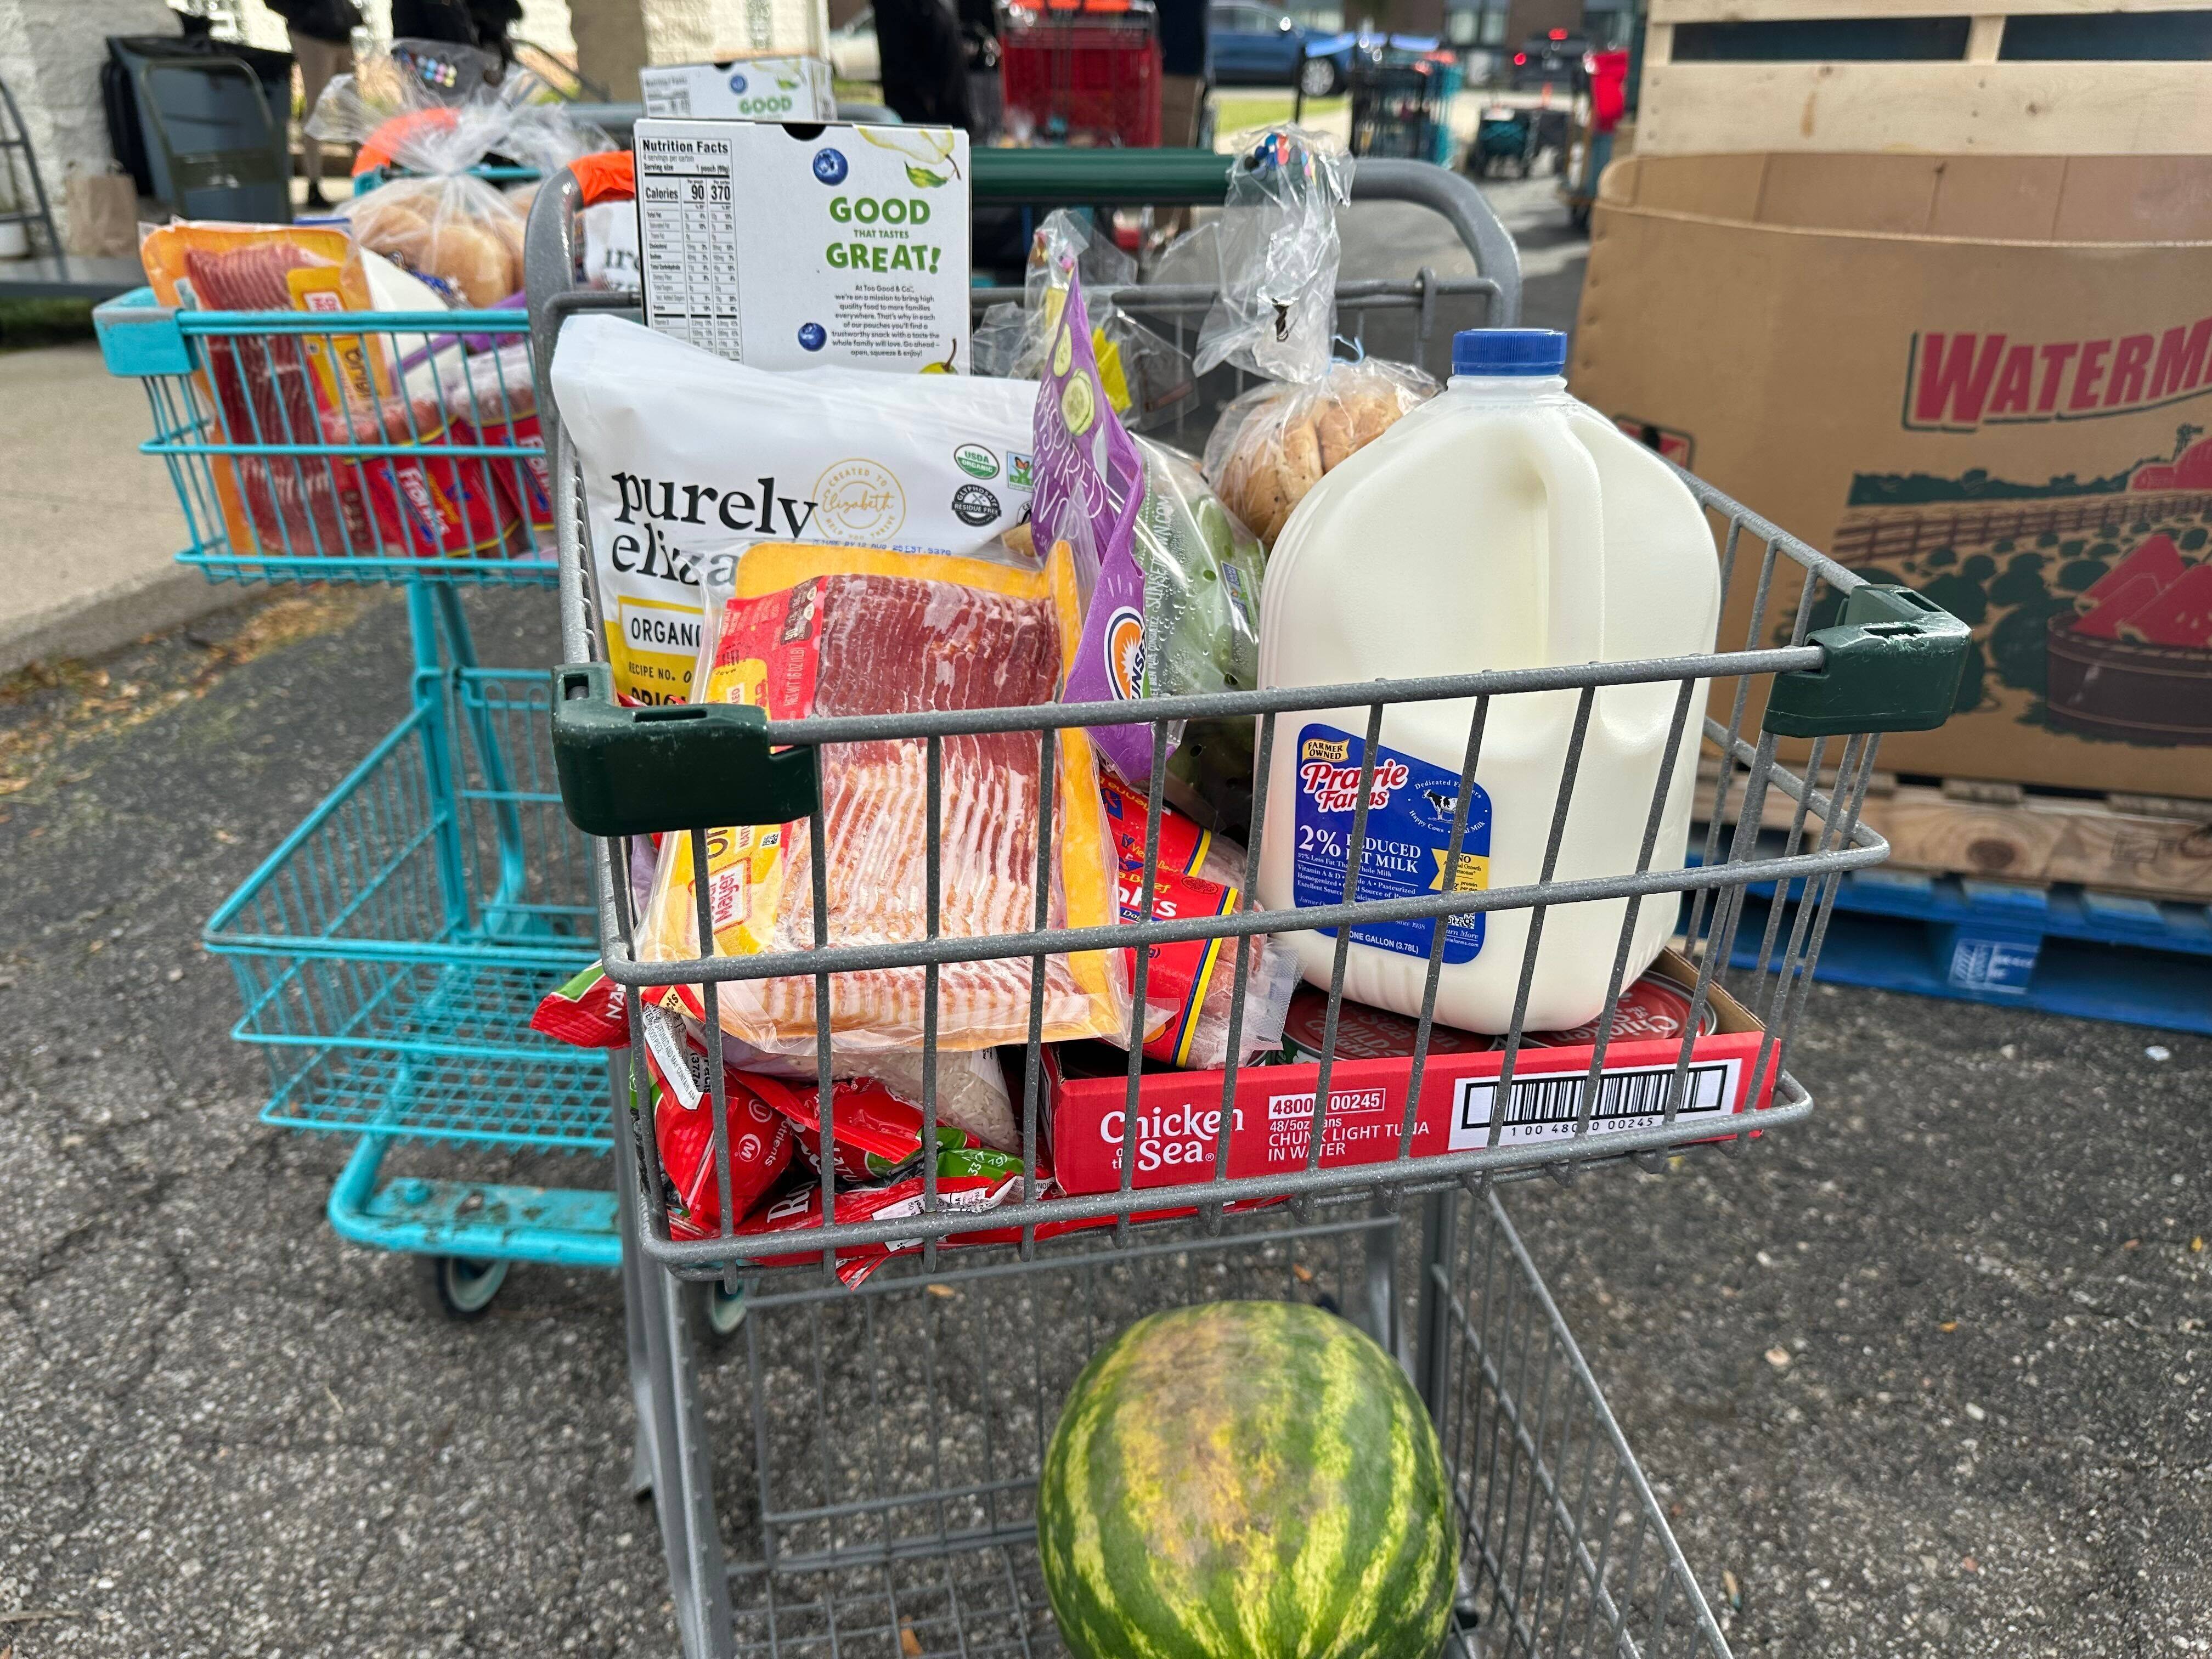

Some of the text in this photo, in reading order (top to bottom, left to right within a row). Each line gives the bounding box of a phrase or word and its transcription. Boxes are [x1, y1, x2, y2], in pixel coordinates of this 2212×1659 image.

[738, 96, 793, 114] GOOD
[643, 139, 729, 154] Nutrition Facts
[644, 163, 662, 172] Serving
[646, 185, 730, 200] Calories 90 370
[830, 196, 931, 225] GOOD
[854, 229, 909, 239] THAT TASTES
[826, 242, 941, 274] GREAT!
[920, 295, 934, 303] high
[1915, 318, 2212, 422] WATERM
[962, 460, 992, 473] ORGANIC
[964, 450, 989, 464] USDA
[829, 468, 887, 487] CREATED TO
[823, 489, 895, 514] Elizabeth
[957, 486, 998, 507] GLYPHOSATE
[955, 503, 981, 512] RESIDUE
[612, 522, 740, 586] eliza
[631, 617, 701, 647] ORGANI
[629, 662, 675, 681] RECIPE NO.
[783, 691, 798, 707] NET
[1308, 742, 1343, 752] FARMER
[1309, 749, 1341, 759] OWNED
[1302, 760, 1408, 791] Prarie
[1108, 782, 1149, 811] ienna
[1414, 780, 1481, 798] Dedicated Faers
[1317, 790, 1389, 810] Fars
[1409, 809, 1485, 833] Happy Cows Milk
[1299, 825, 1341, 857] 2%
[1346, 833, 1421, 859] RDUCED
[1297, 864, 1321, 876] Vitamin
[1311, 855, 1392, 878] Less Fat Tha hole Milk
[1375, 854, 1418, 873] MILK
[1129, 874, 1172, 894] Bef
[1297, 872, 1337, 887] Homogenized
[1361, 887, 1383, 897] Source
[1297, 880, 1323, 891] Excellent
[1323, 887, 1343, 896] Source
[1378, 882, 1416, 895] Pasteurized
[714, 873, 740, 924] Mayer
[1349, 930, 1419, 955] ONE GALLON (3.78L)
[1460, 930, 1479, 939] More
[1339, 1018, 1390, 1049] WILD
[676, 1066, 689, 1092] CONTAIN
[1272, 1093, 1380, 1115] 4800 00245
[1100, 1103, 1245, 1143] Chicken
[1269, 1118, 1342, 1132] 48/5oz ans
[1333, 1125, 1380, 1142] LIGHT
[1385, 1121, 1430, 1137] TUA
[1511, 1117, 1654, 1137] 1 00 4800 00245
[765, 1120, 788, 1166] utrients
[1268, 1142, 1346, 1161] IN WTER
